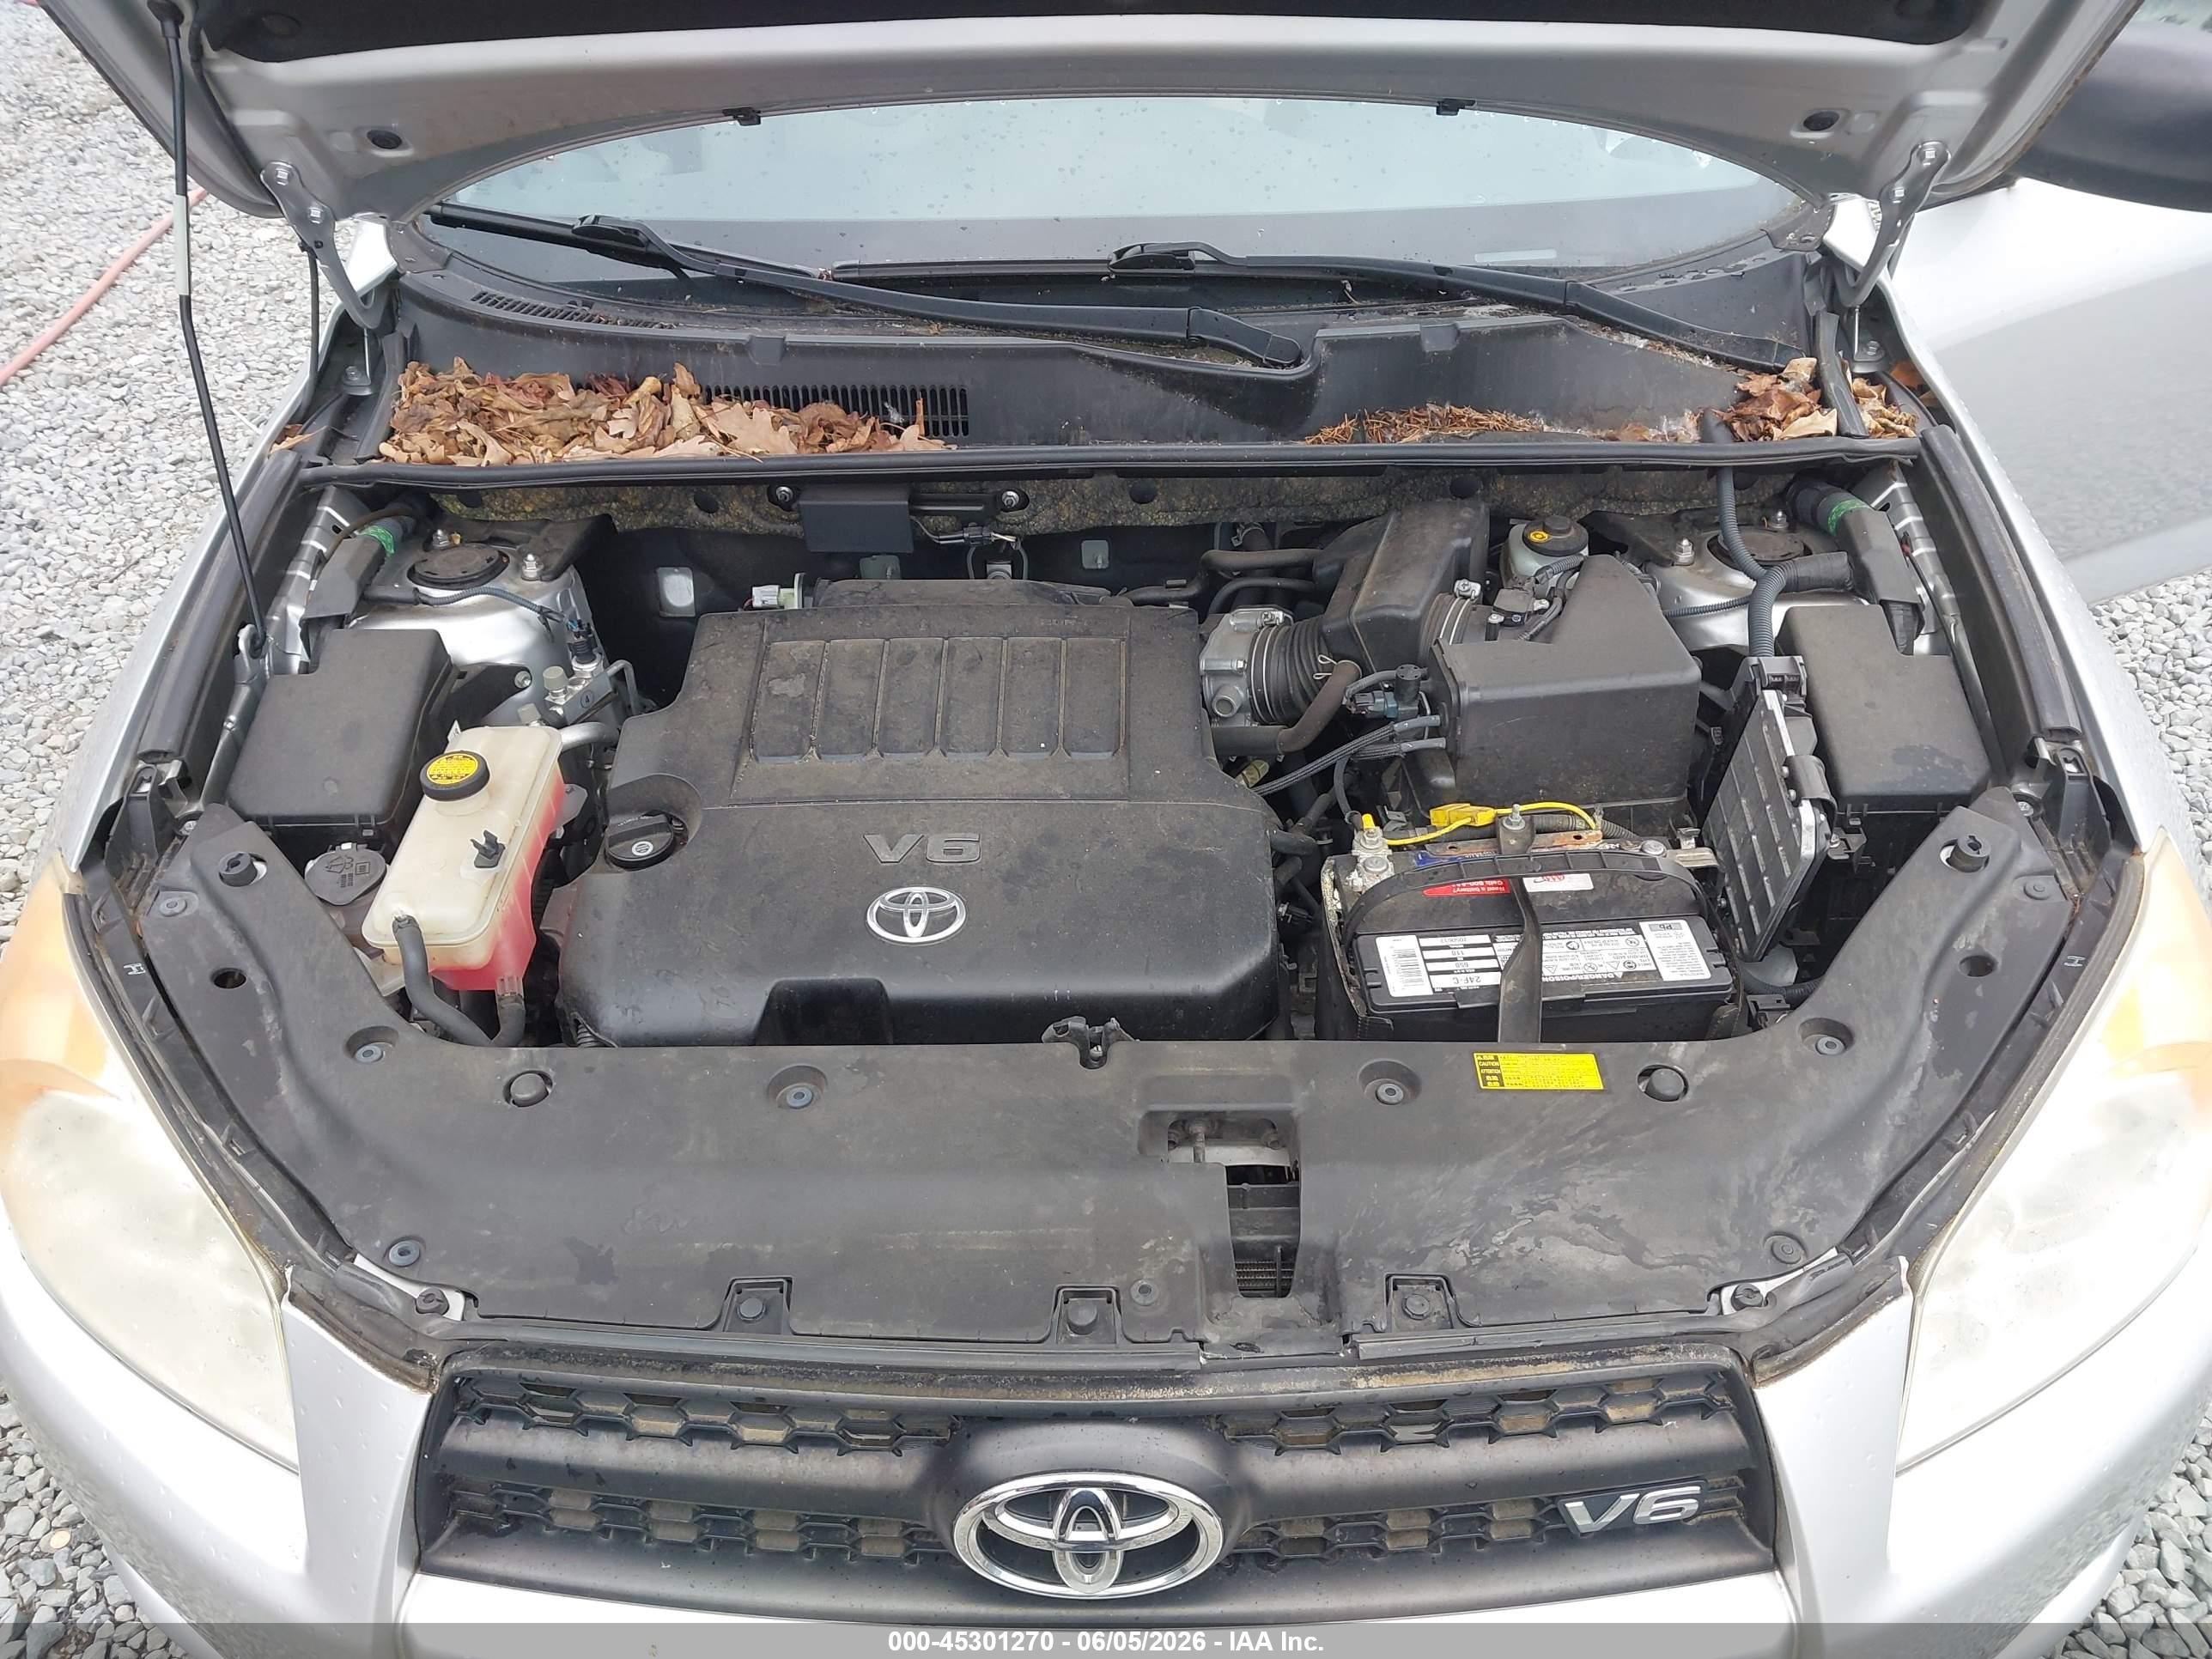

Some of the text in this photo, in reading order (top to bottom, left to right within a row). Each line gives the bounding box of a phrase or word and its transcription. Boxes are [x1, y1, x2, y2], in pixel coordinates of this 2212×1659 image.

[862, 832, 981, 865] V6
[1452, 975, 1482, 985] 24F-C
[1565, 1486, 1702, 1534] V6
